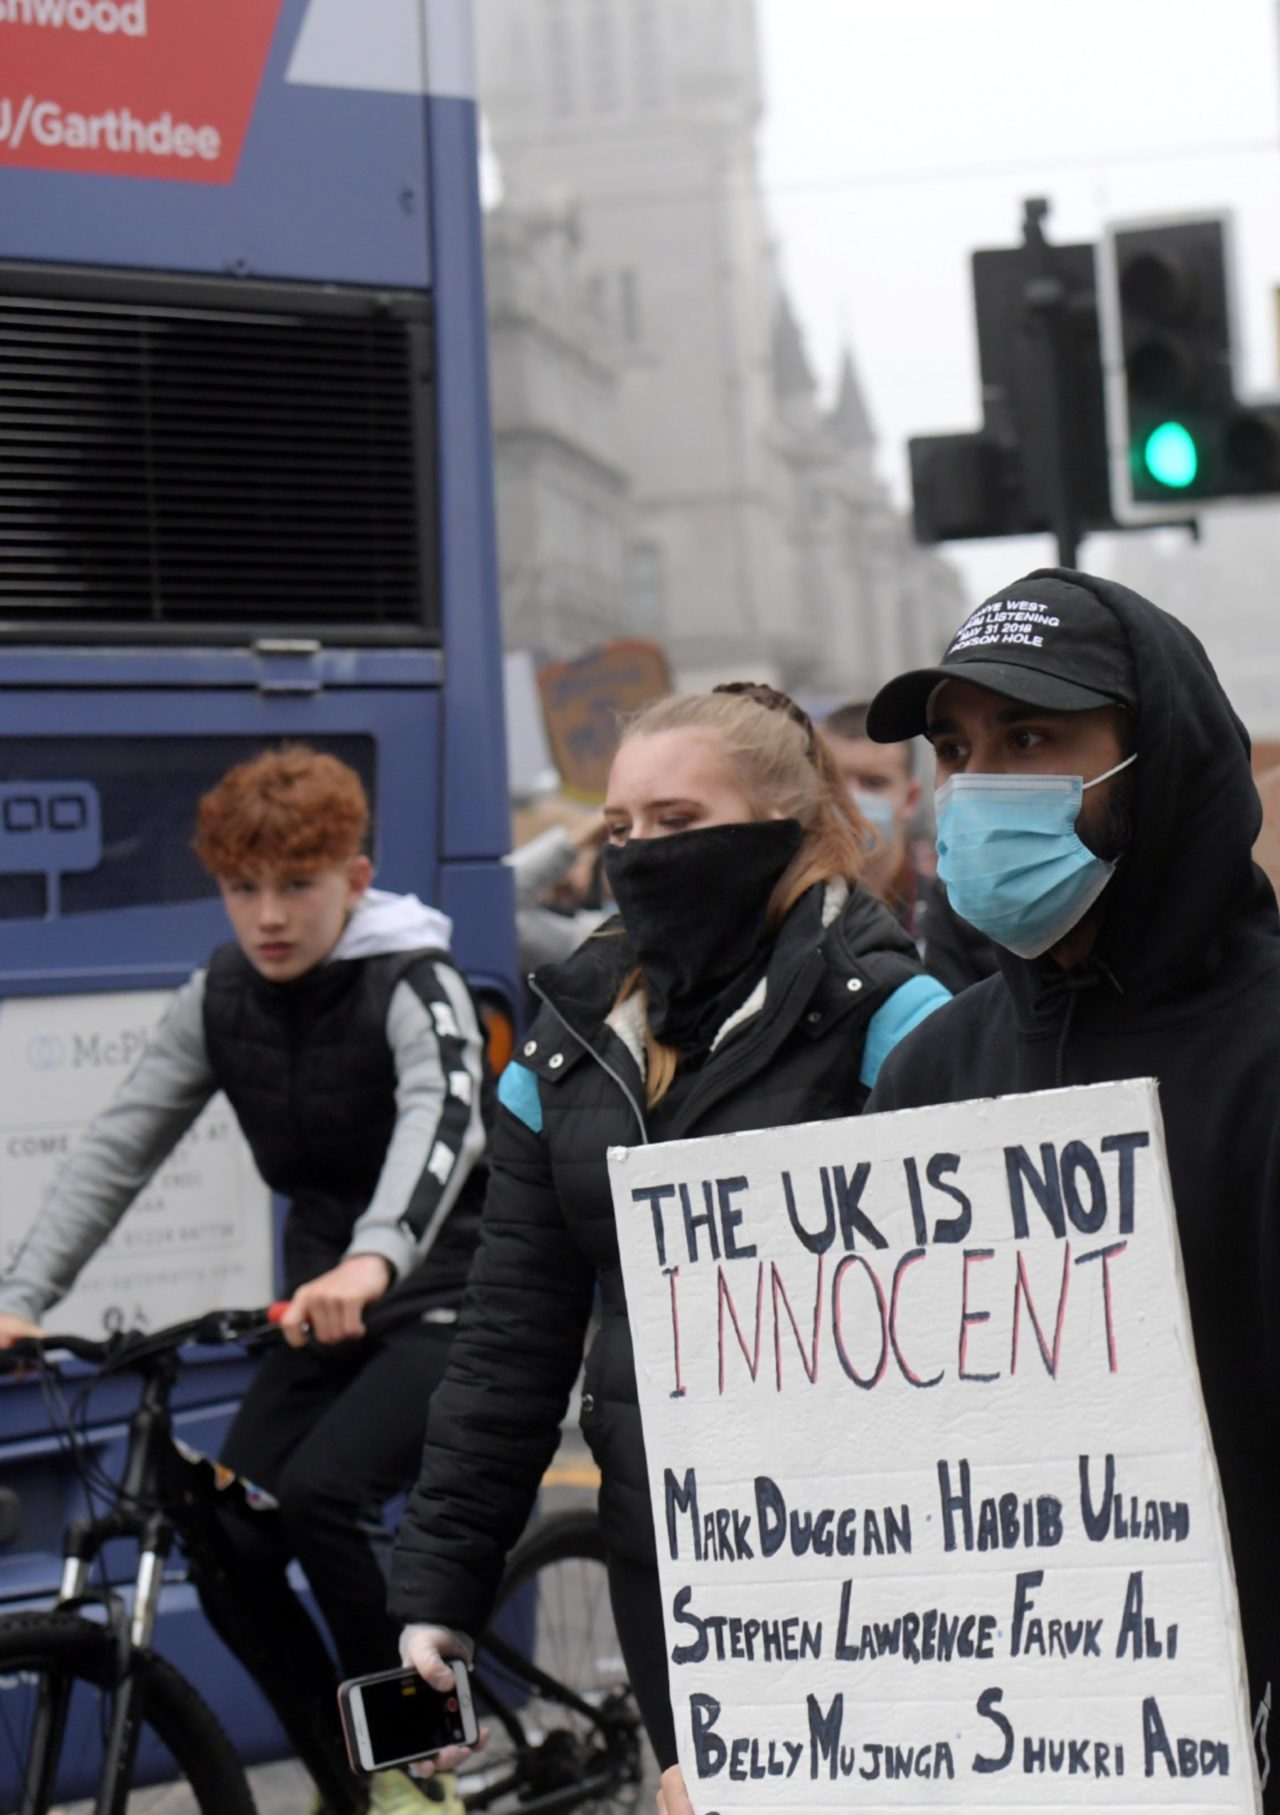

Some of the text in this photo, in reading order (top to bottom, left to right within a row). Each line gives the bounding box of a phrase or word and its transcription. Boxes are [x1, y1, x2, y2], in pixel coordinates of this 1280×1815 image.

[0, 0, 146, 36] nwood
[984, 623, 999, 634] 31
[1001, 622, 1033, 634] 2018
[986, 612, 1060, 627] LISTENING
[1006, 600, 1048, 612] WEST
[1001, 634, 1044, 648] HOLE
[632, 1131, 1149, 1266] THE UK IS NOT
[662, 1241, 1127, 1398] INNOCENT
[937, 1458, 1064, 1553] HABIB
[671, 1585, 822, 1665] STEPHEN
[972, 1687, 1124, 1778] SHUKRI
